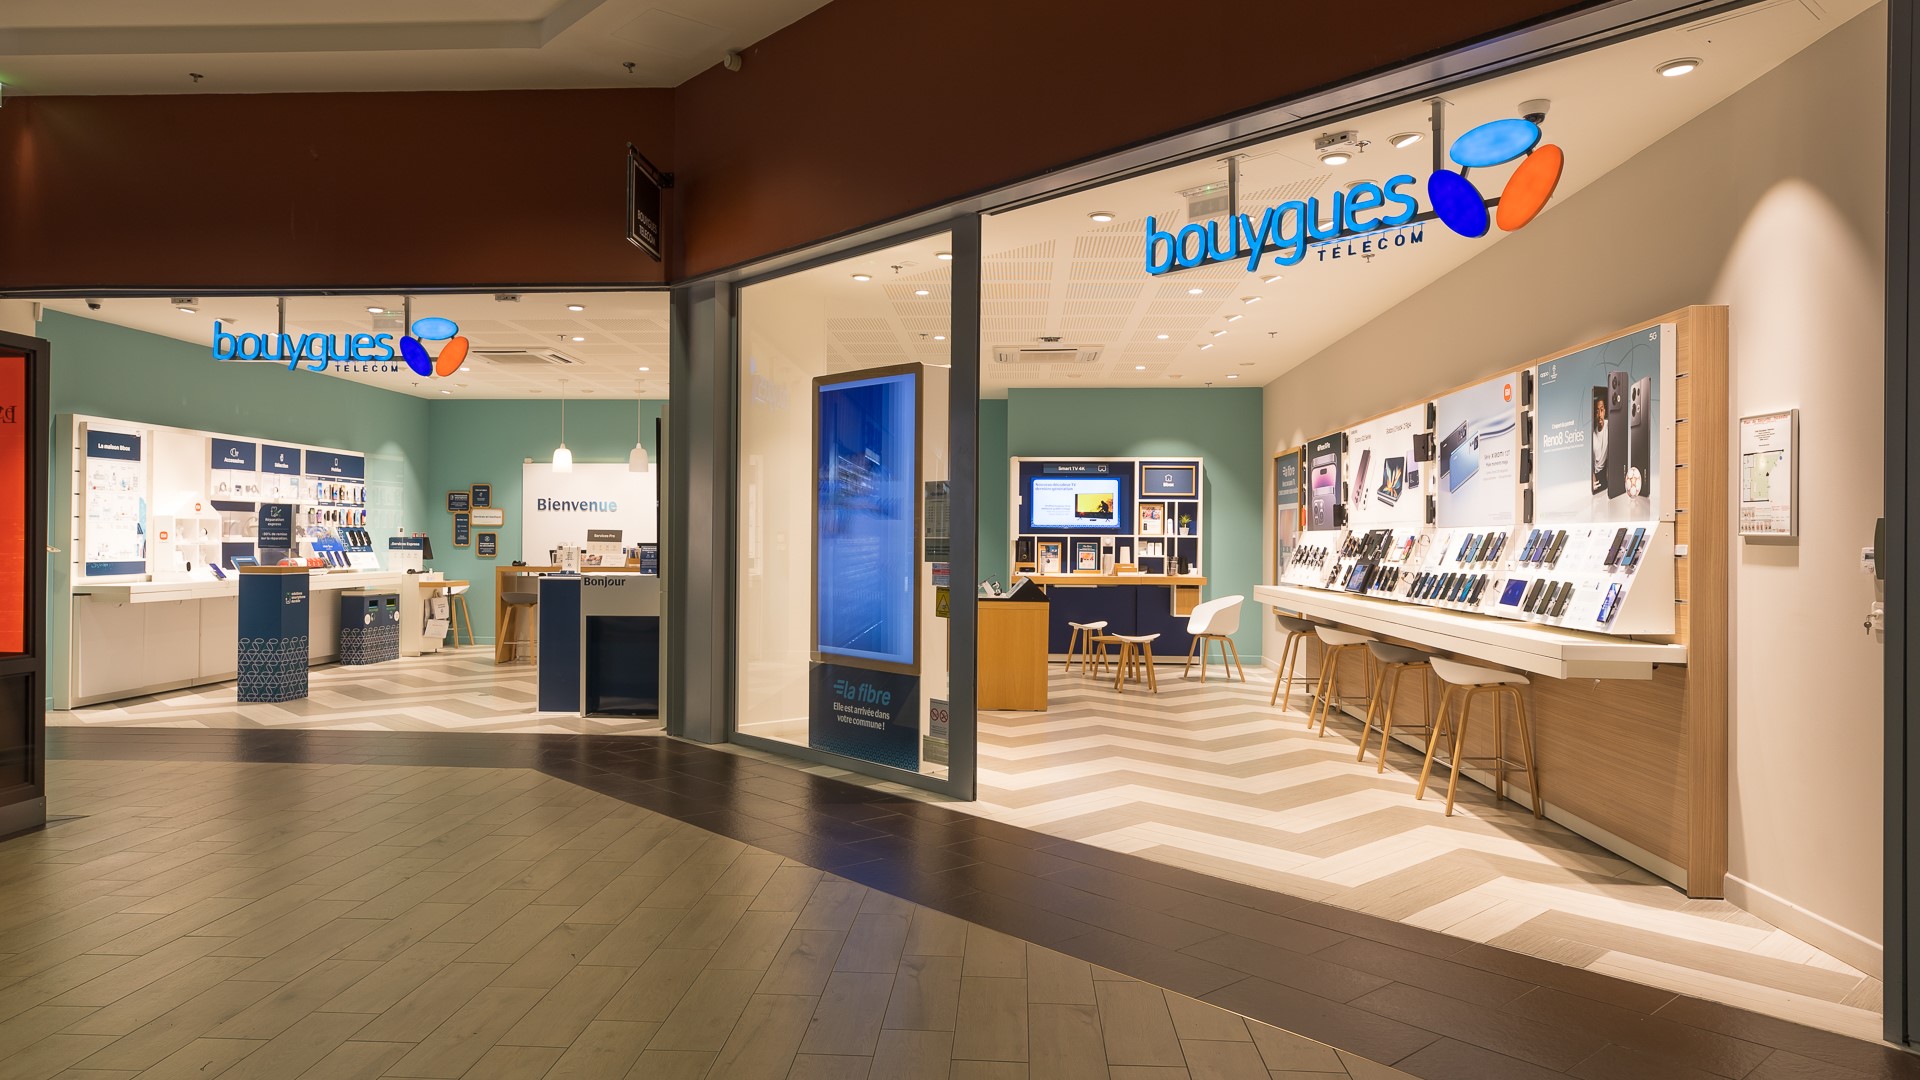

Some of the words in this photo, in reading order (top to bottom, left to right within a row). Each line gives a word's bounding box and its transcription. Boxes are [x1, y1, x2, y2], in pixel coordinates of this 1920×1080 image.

[637, 209, 658, 235] BOUYGUES
[1145, 174, 1420, 275] bouygues
[638, 224, 656, 246] TELECOM
[1317, 230, 1425, 262] TELECOM
[213, 321, 395, 371] bouygues
[1648, 331, 1658, 342] 5G
[335, 364, 400, 373] TELECOM
[1543, 431, 1563, 447] Reno8
[1564, 429, 1584, 444] Series
[537, 497, 618, 512] Bienvenue
[583, 576, 626, 588] Bonjour
[843, 680, 856, 700] la
[857, 683, 891, 706] fibre
[833, 701, 844, 712] Elle
[844, 705, 853, 713] est
[853, 706, 875, 717] arrivée
[874, 709, 890, 720] dans
[836, 714, 852, 724] votre
[852, 717, 882, 730] commune
